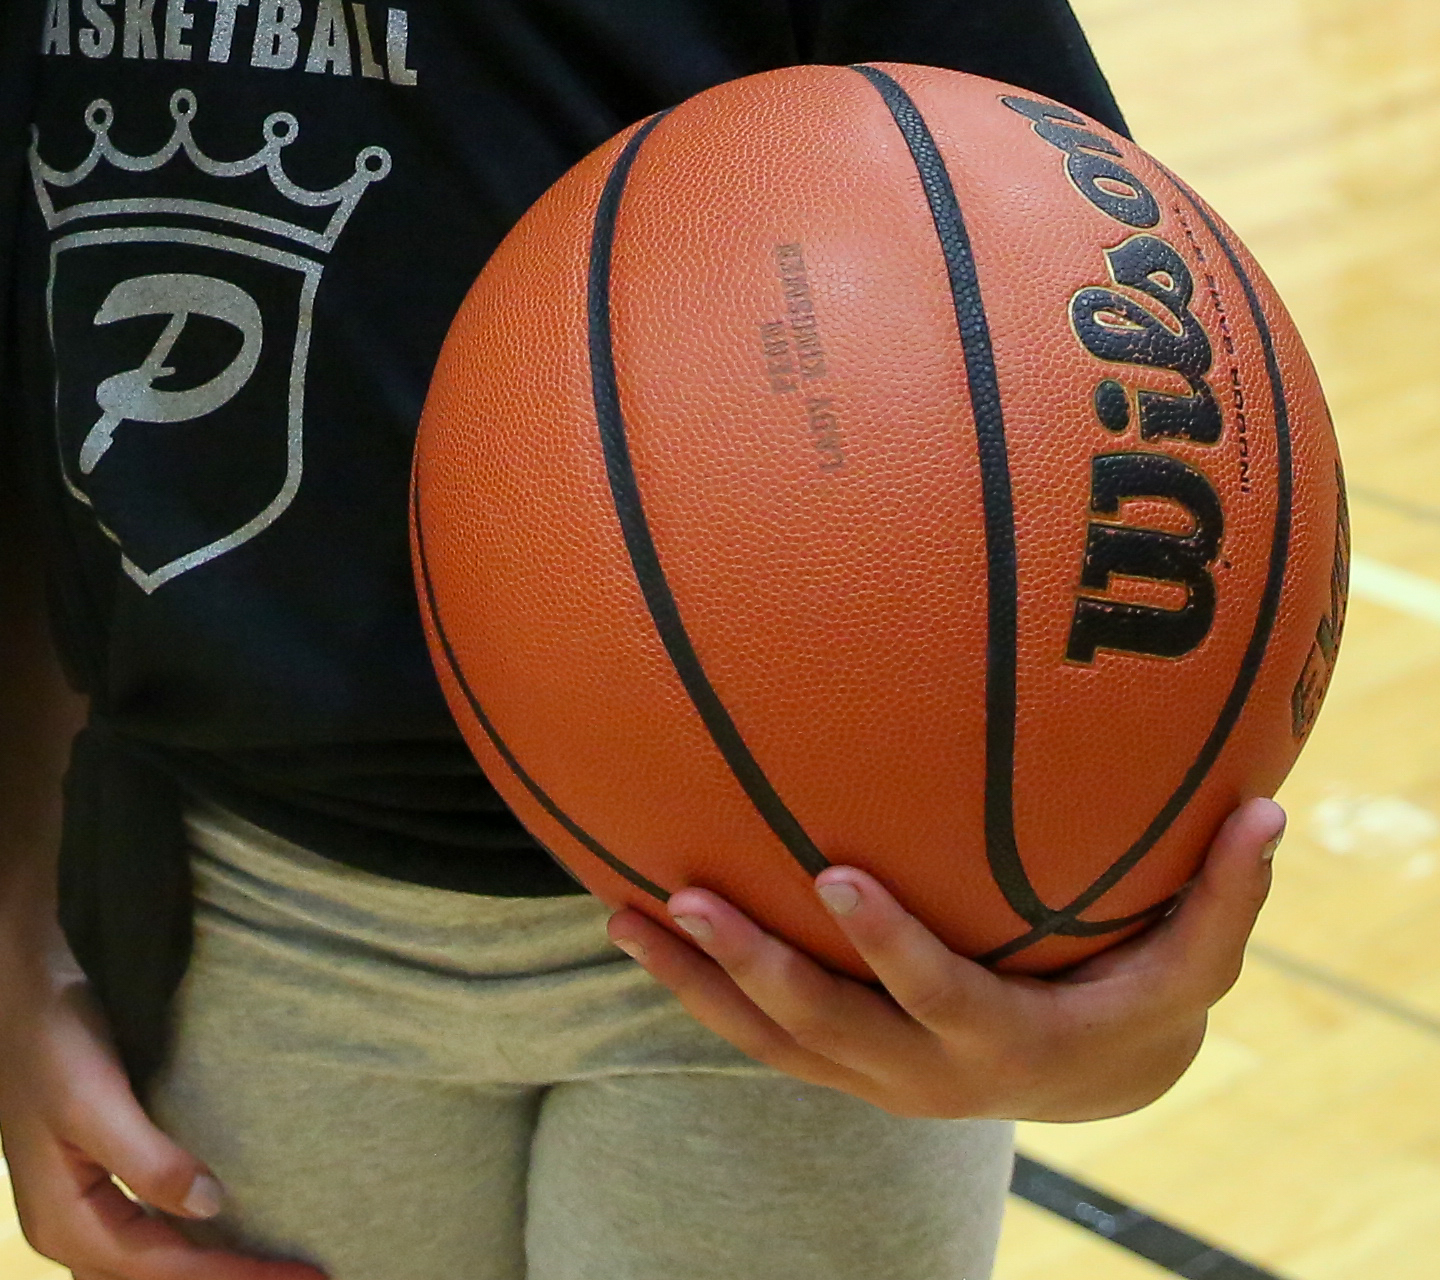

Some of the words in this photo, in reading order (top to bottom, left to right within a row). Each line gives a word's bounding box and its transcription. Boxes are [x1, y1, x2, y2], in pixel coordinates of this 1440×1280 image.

[79, 272, 264, 475] P
[776, 243, 828, 380] KINGSMEN
[1204, 272, 1234, 355] GAME
[807, 396, 845, 474] LADY
[998, 92, 1225, 666] Wilson
[1230, 367, 1252, 493] INDOOR
